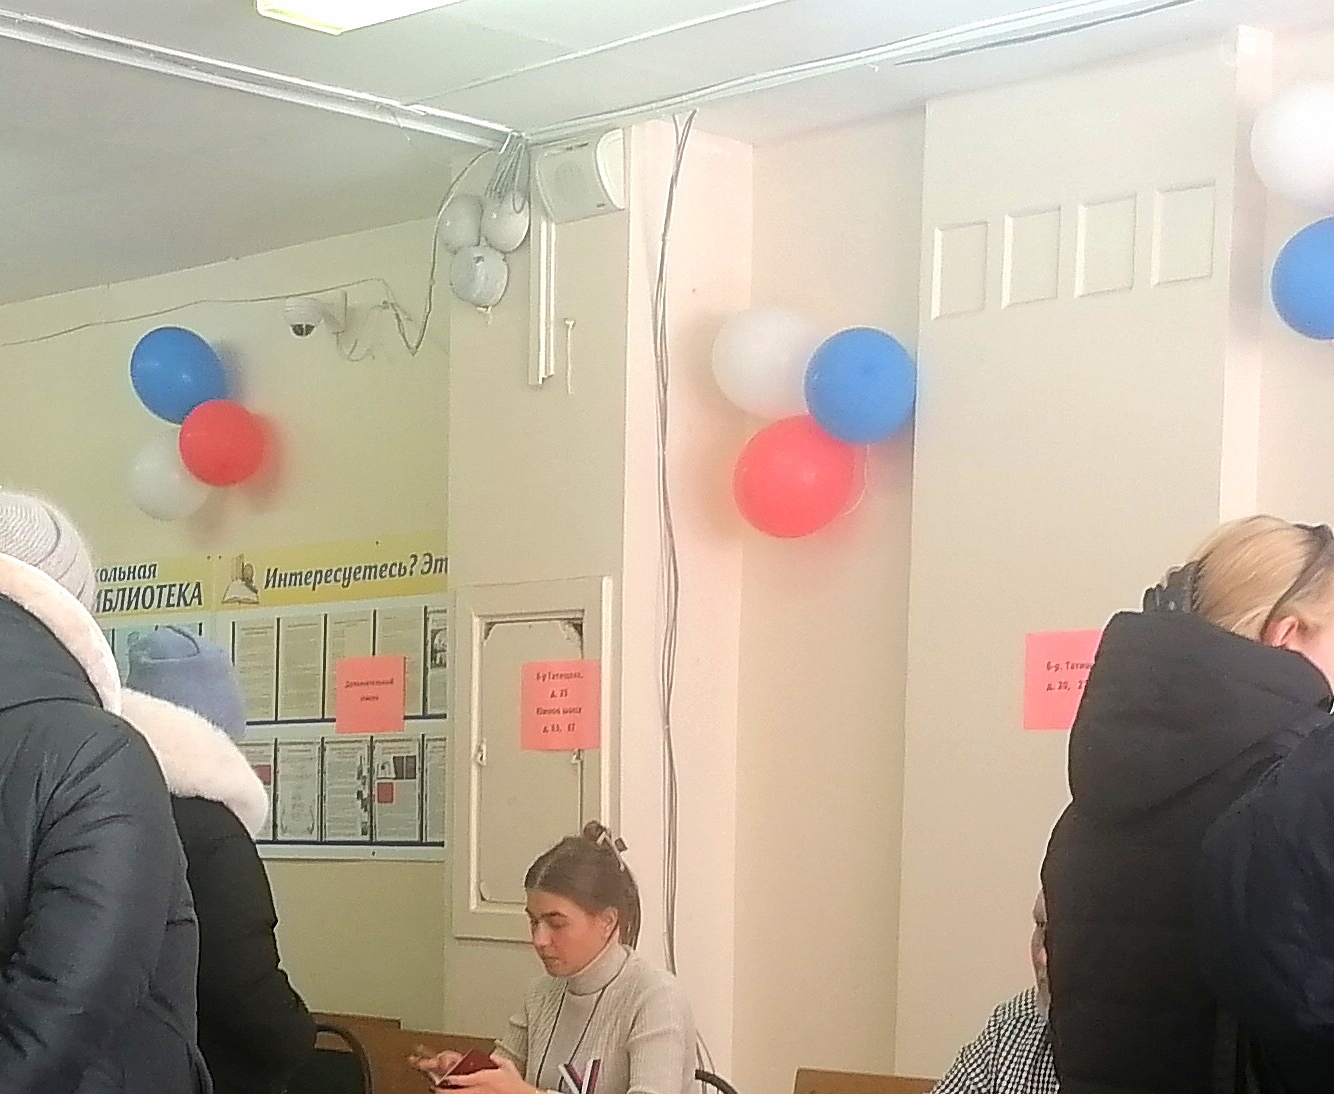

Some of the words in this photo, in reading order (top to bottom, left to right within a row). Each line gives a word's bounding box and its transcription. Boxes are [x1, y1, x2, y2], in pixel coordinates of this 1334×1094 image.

[95, 563, 158, 583] ольная
[264, 554, 418, 591] Интересуетесь?
[420, 552, 448, 575] Эт
[94, 581, 202, 614] ИБЛИОТЕКА
